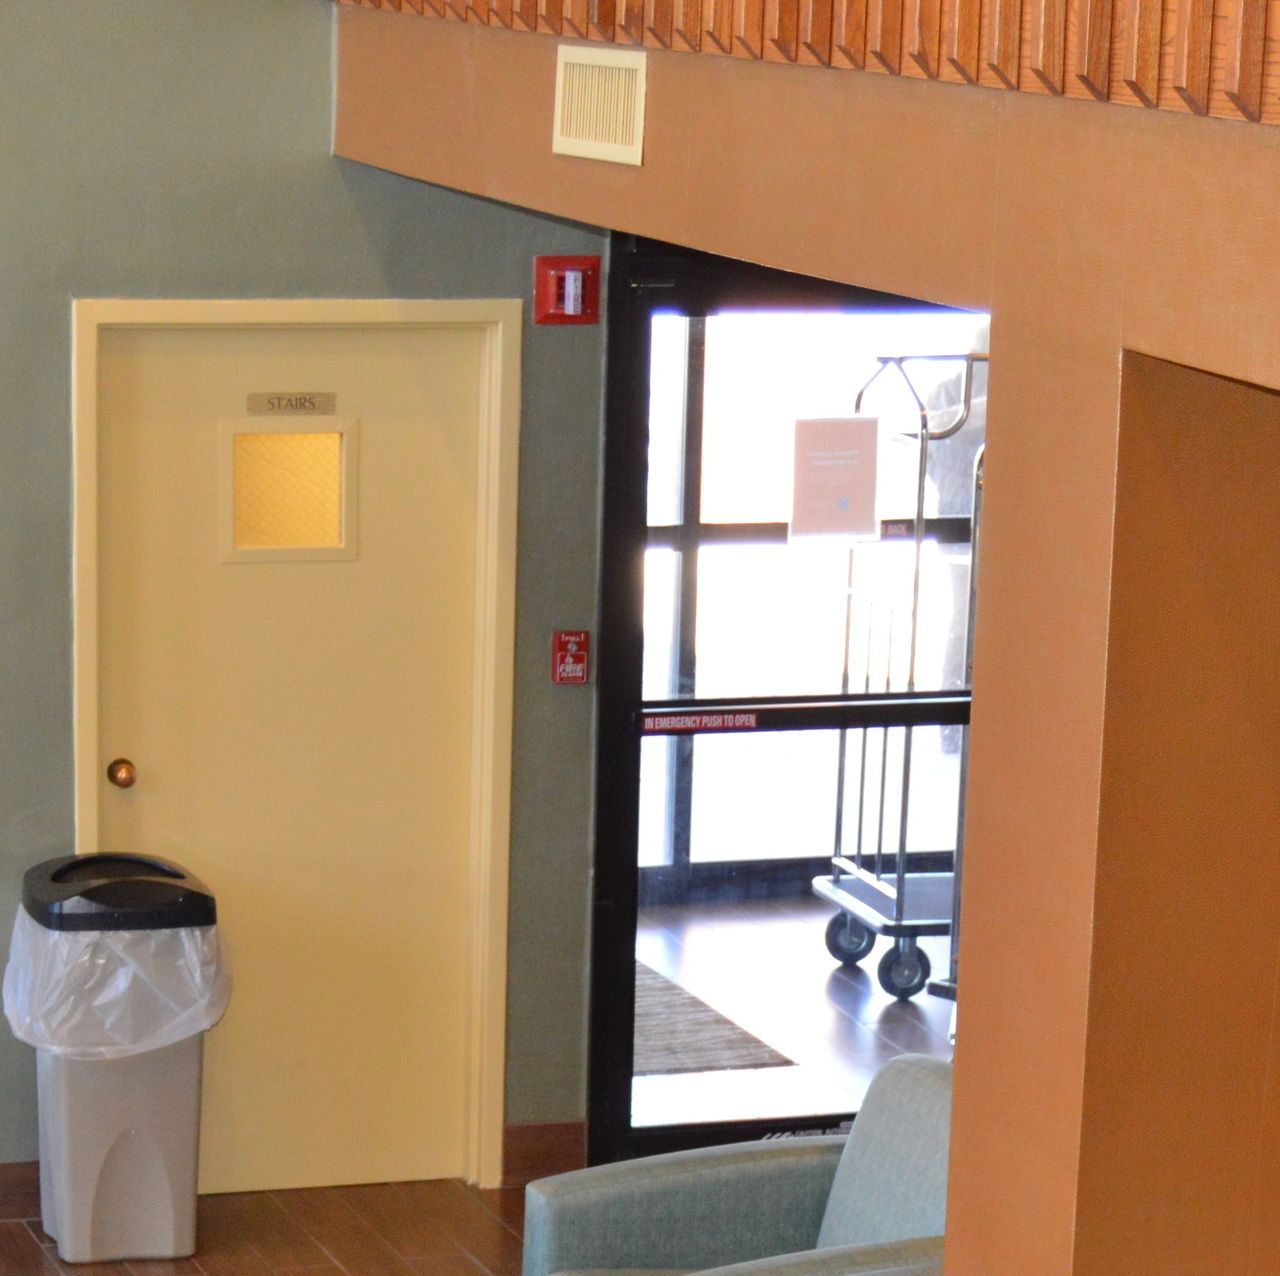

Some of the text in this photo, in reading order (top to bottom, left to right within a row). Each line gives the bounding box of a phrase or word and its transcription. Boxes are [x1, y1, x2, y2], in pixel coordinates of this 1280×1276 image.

[267, 396, 316, 411] STAIRS
[644, 713, 756, 730] IN EMERGENCY PUSH TO OPEN
